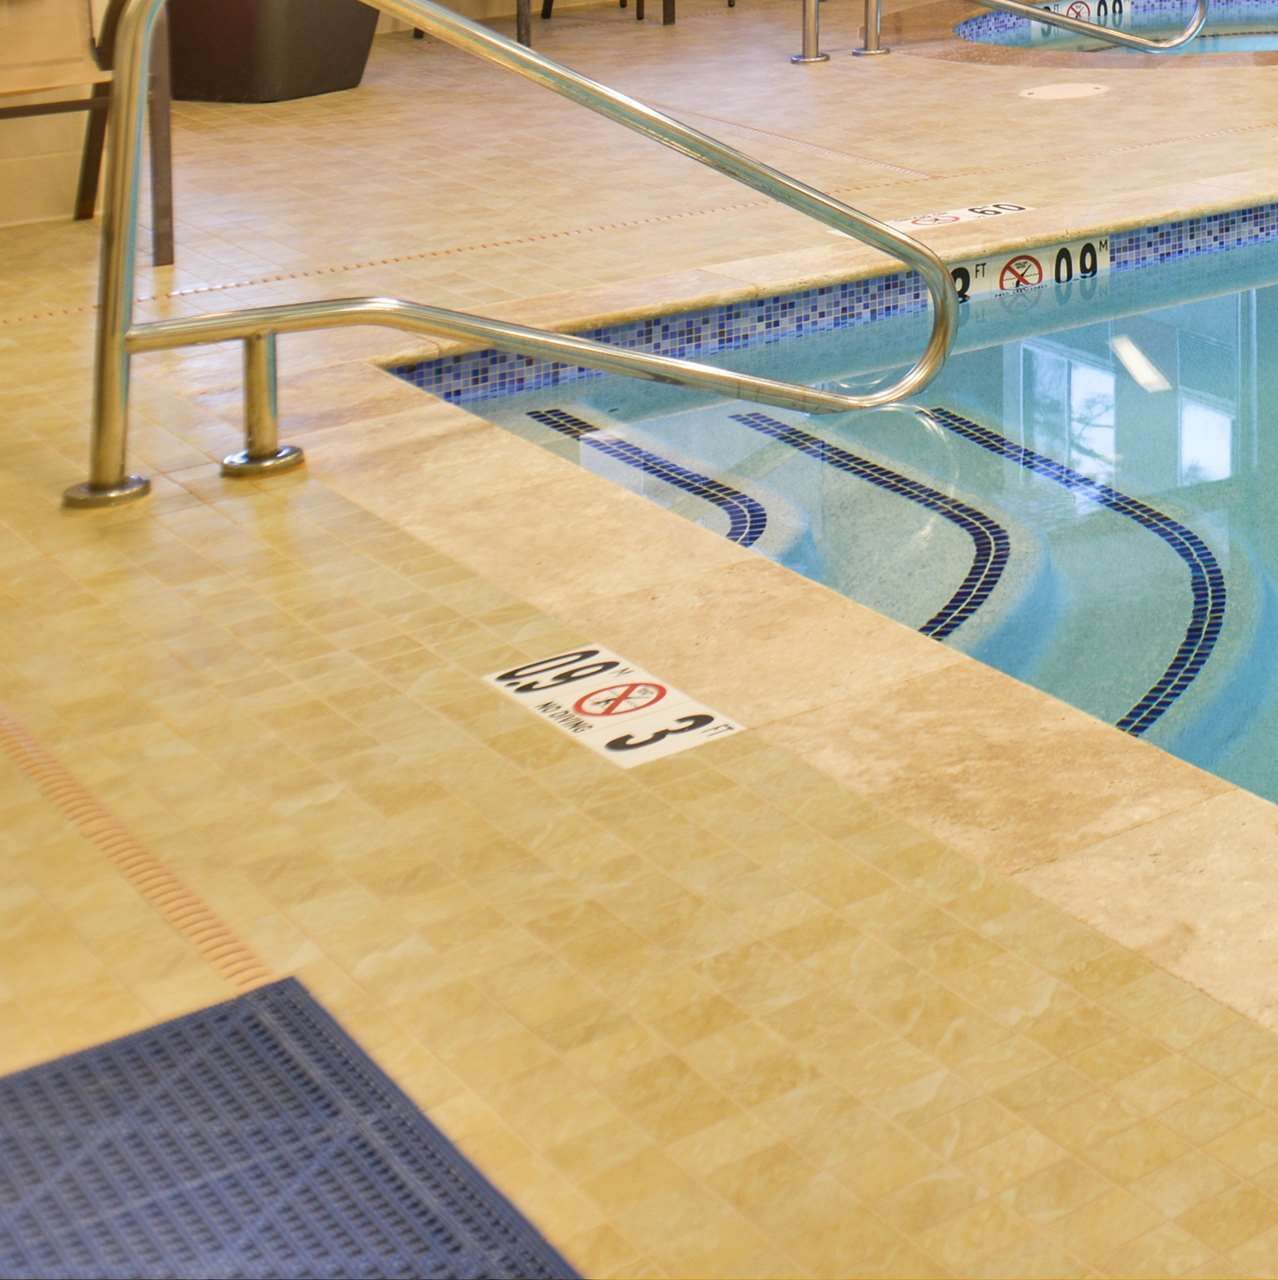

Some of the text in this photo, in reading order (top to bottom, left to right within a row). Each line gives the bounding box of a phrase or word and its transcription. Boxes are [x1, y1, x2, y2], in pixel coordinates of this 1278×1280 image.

[1098, 240, 1108, 252] M
[975, 262, 986, 279] FT
[495, 648, 620, 694] 0.9
[535, 700, 594, 734] NO DIVING
[604, 714, 714, 751] 3
